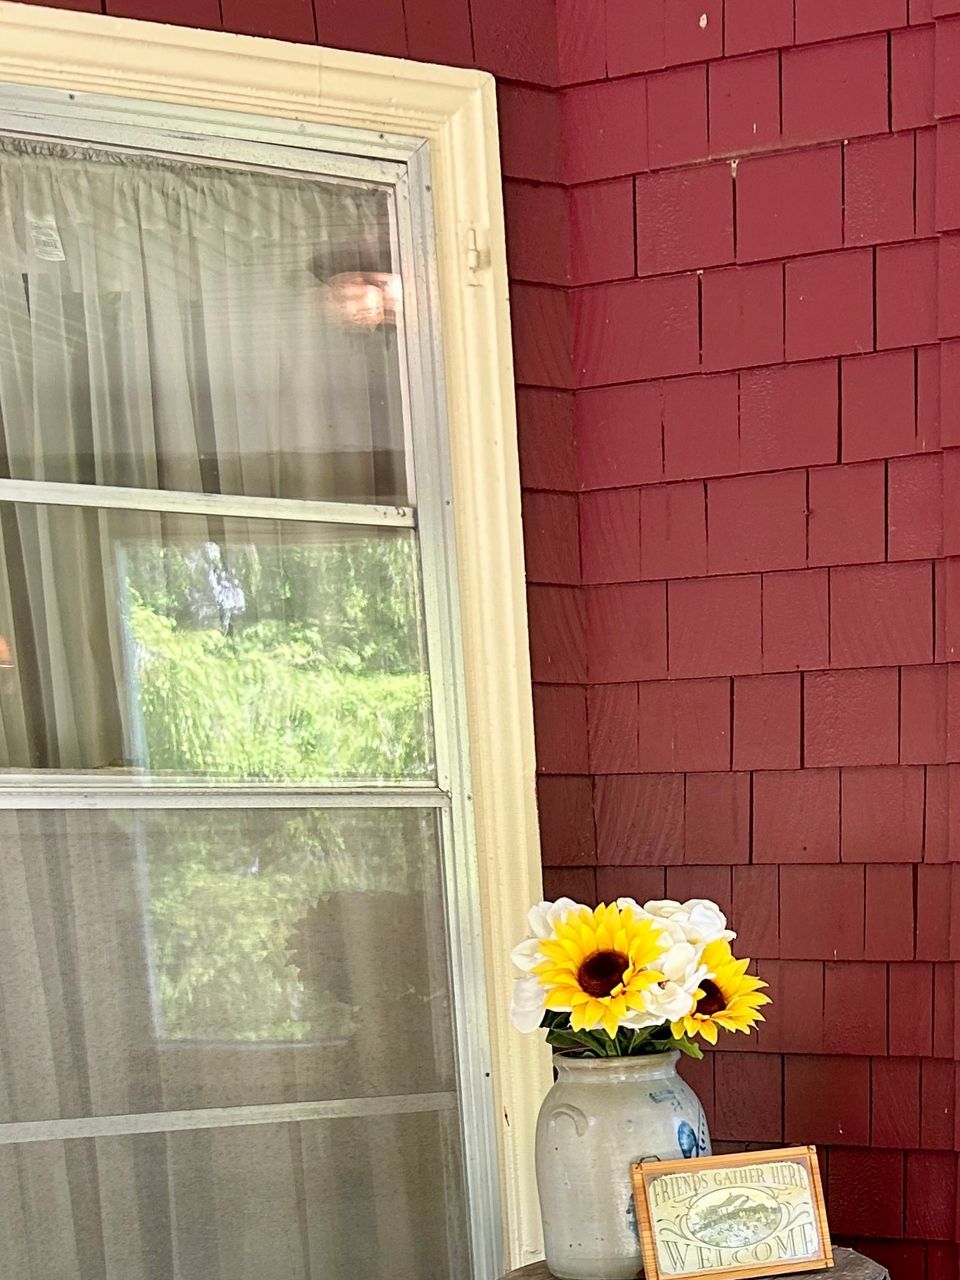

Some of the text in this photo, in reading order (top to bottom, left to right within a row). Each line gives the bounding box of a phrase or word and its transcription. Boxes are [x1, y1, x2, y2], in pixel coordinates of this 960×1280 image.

[653, 1163, 808, 1206] FRIENDS GATHER HERE
[661, 1222, 817, 1272] WELCOME
